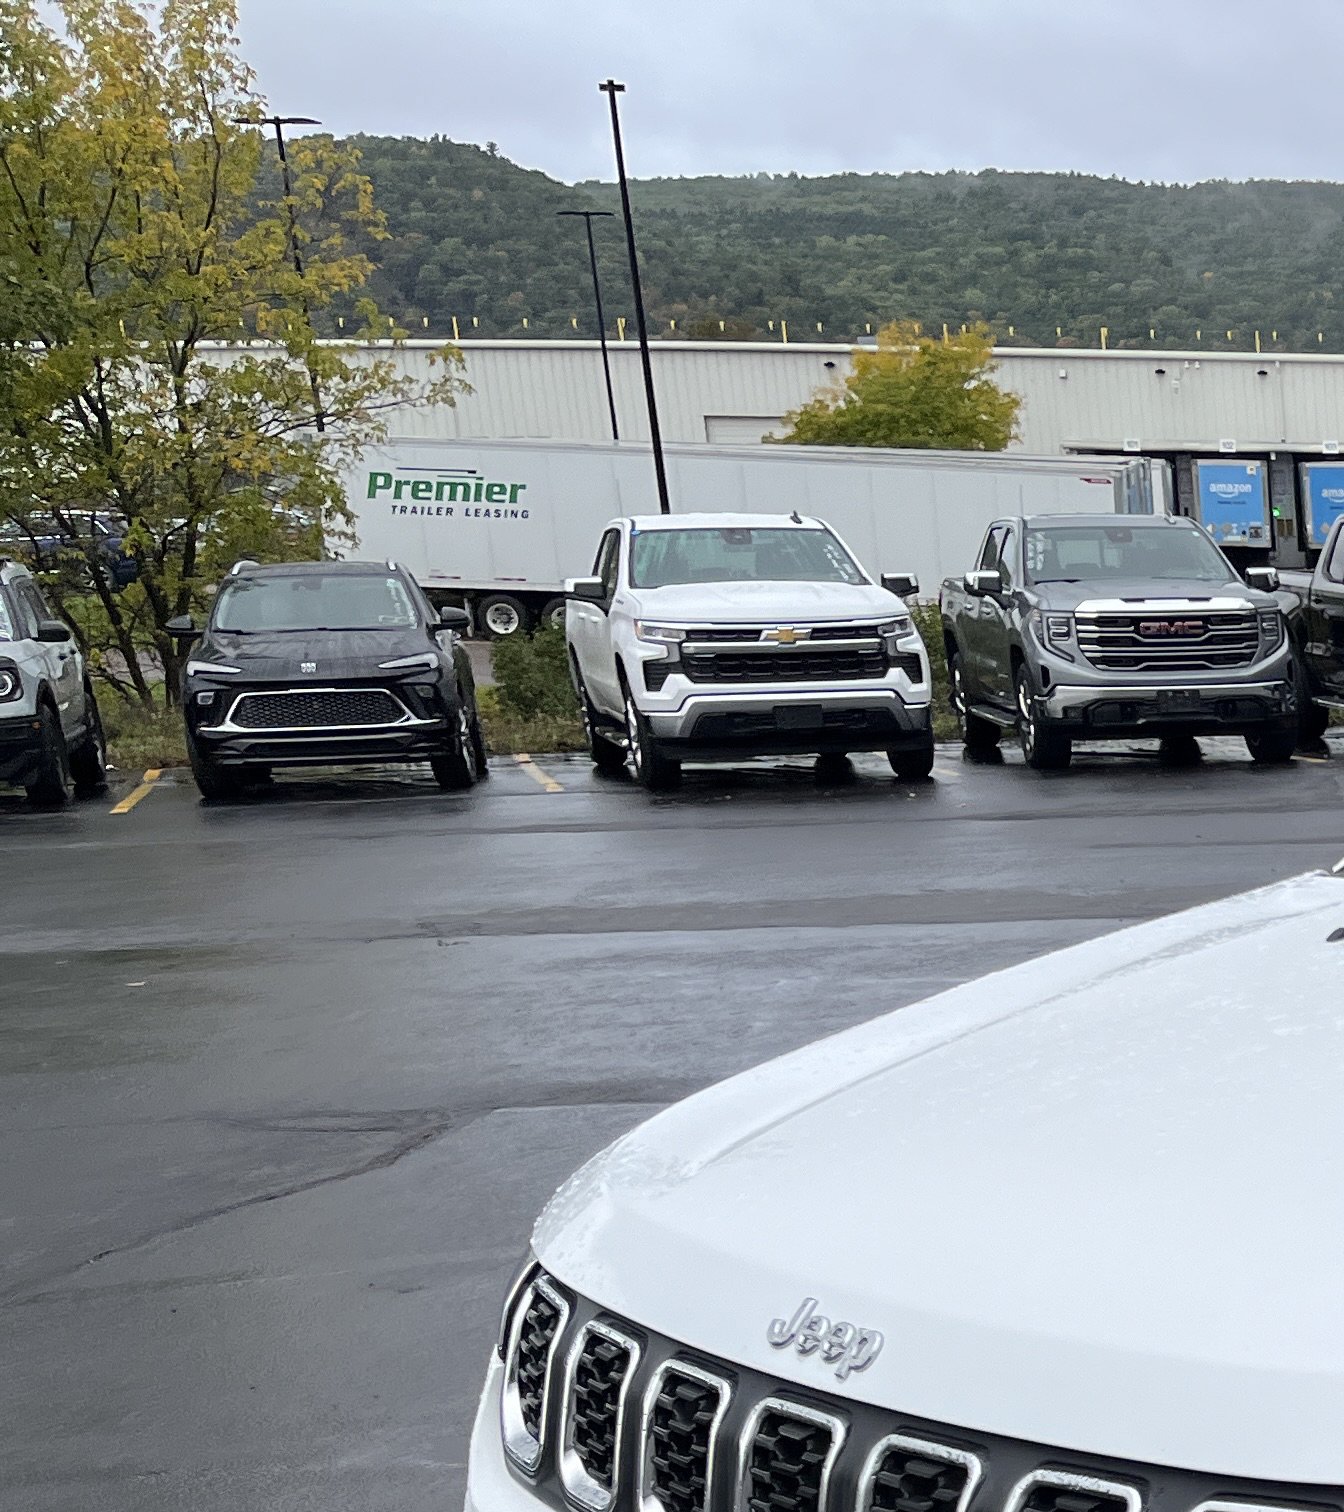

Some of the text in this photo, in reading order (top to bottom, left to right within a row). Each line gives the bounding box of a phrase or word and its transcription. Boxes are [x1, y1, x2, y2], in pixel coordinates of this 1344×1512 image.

[366, 471, 527, 504] Premier
[1209, 482, 1252, 494] amazon
[391, 505, 529, 519] TRAILER LEASING
[1140, 621, 1203, 635] GMC
[767, 1297, 884, 1383] Jeep
